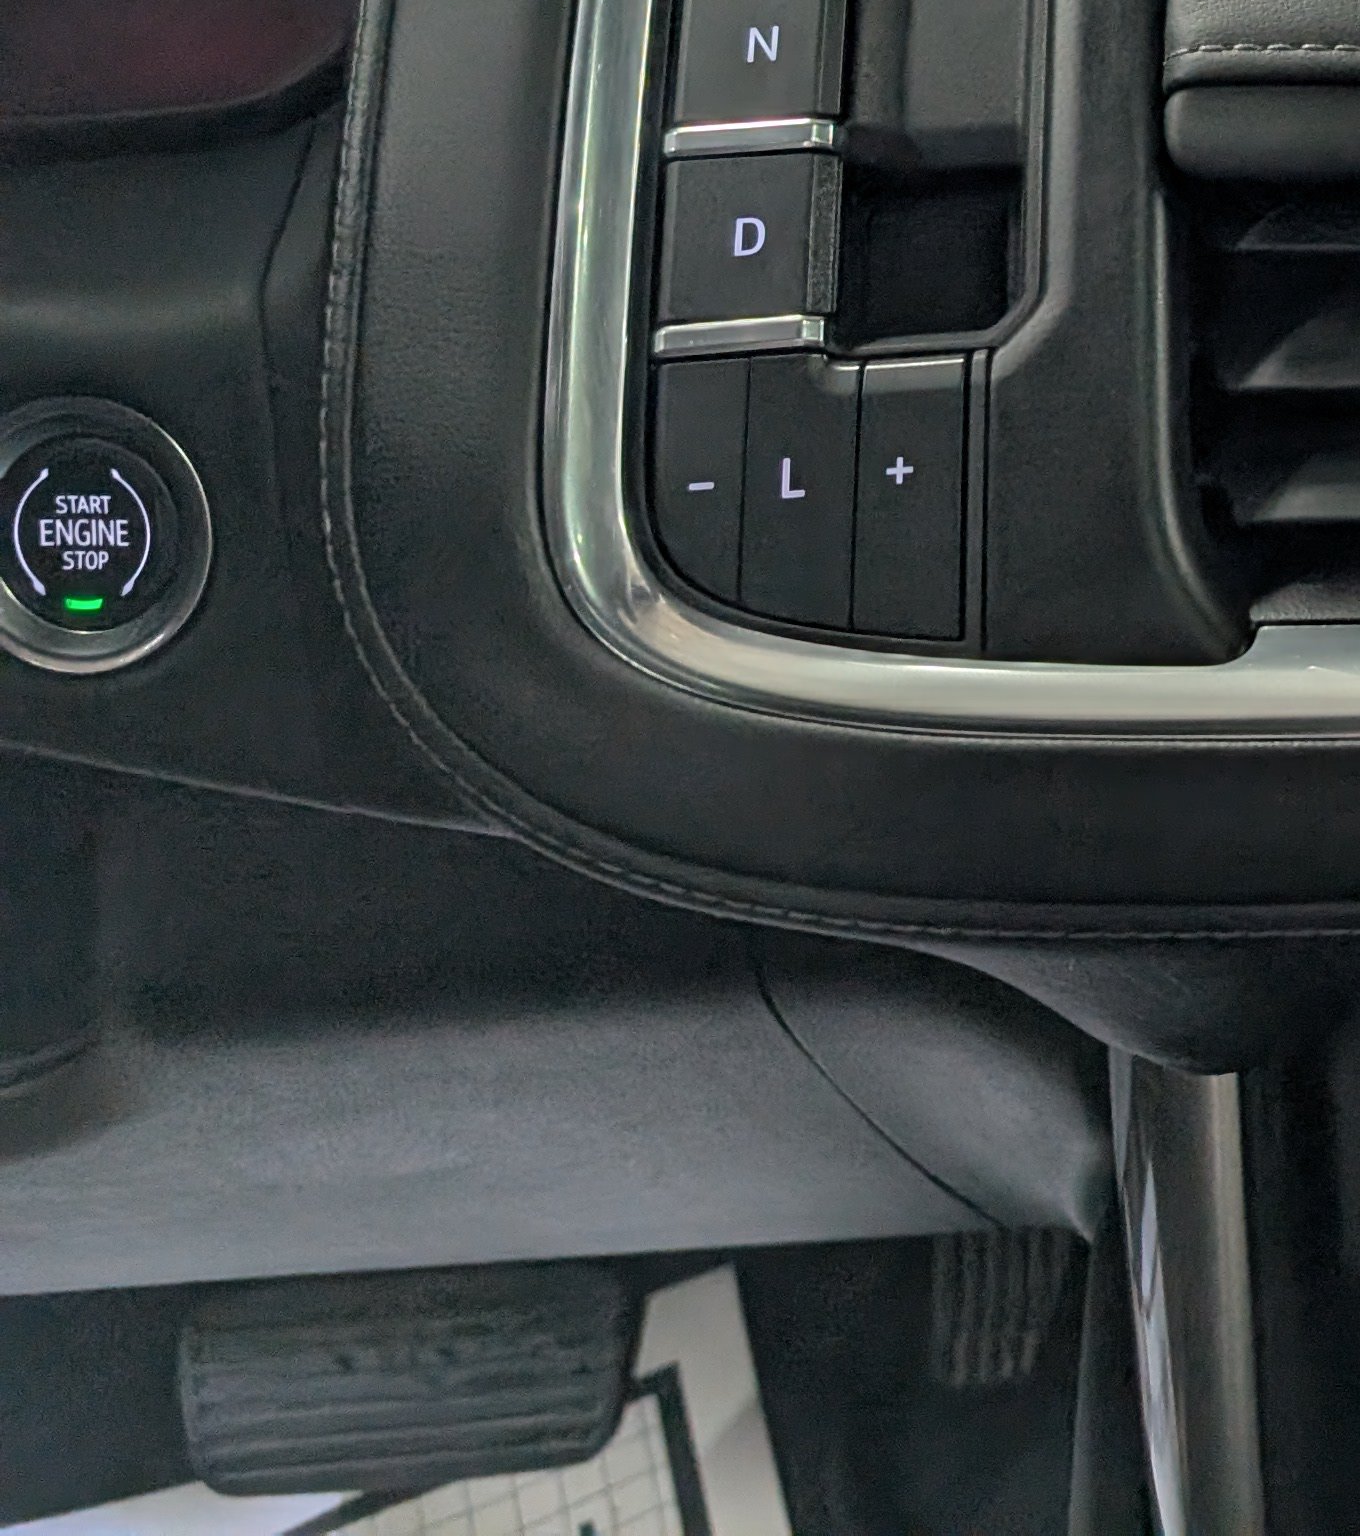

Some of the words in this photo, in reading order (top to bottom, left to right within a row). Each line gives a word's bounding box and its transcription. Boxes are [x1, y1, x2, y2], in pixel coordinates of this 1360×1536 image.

[747, 26, 779, 62] N
[734, 218, 765, 256] D
[782, 458, 805, 498] L
[56, 495, 111, 513] START
[40, 519, 128, 546] ENGINE
[63, 551, 108, 569] STOP
